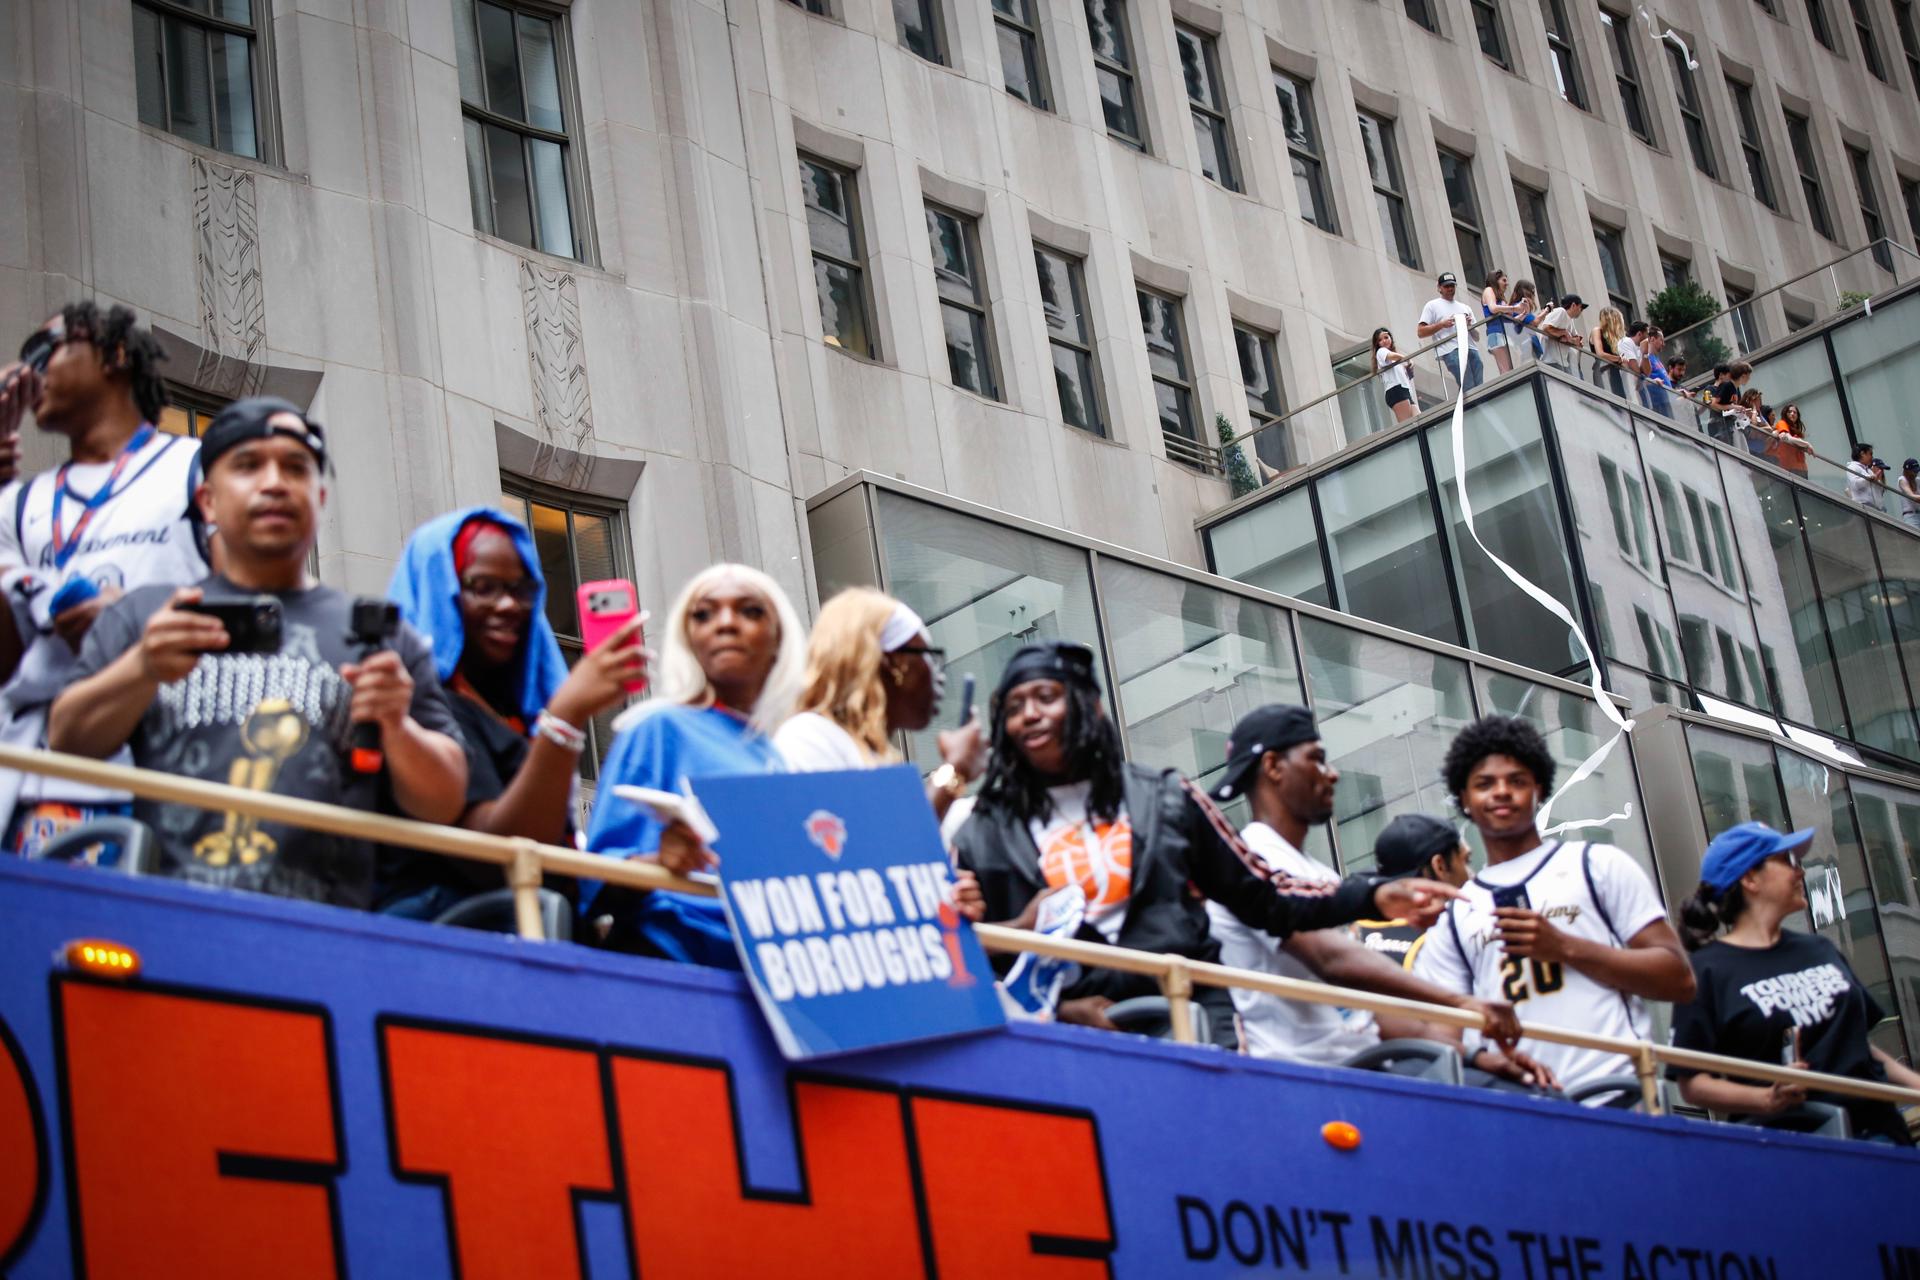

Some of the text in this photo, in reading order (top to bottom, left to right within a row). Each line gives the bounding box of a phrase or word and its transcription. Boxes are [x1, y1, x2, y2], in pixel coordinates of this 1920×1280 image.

[730, 861, 952, 939] WON FOR THE
[756, 923, 953, 1002] BOROUGHS
[1740, 962, 1844, 1002] TOURISM
[1757, 978, 1850, 1019] POWERS
[1789, 998, 1837, 1029] NYC
[1175, 1194, 1352, 1276] DON'T
[1368, 1214, 1502, 1280] MISS
[1507, 1230, 1605, 1280] THE
